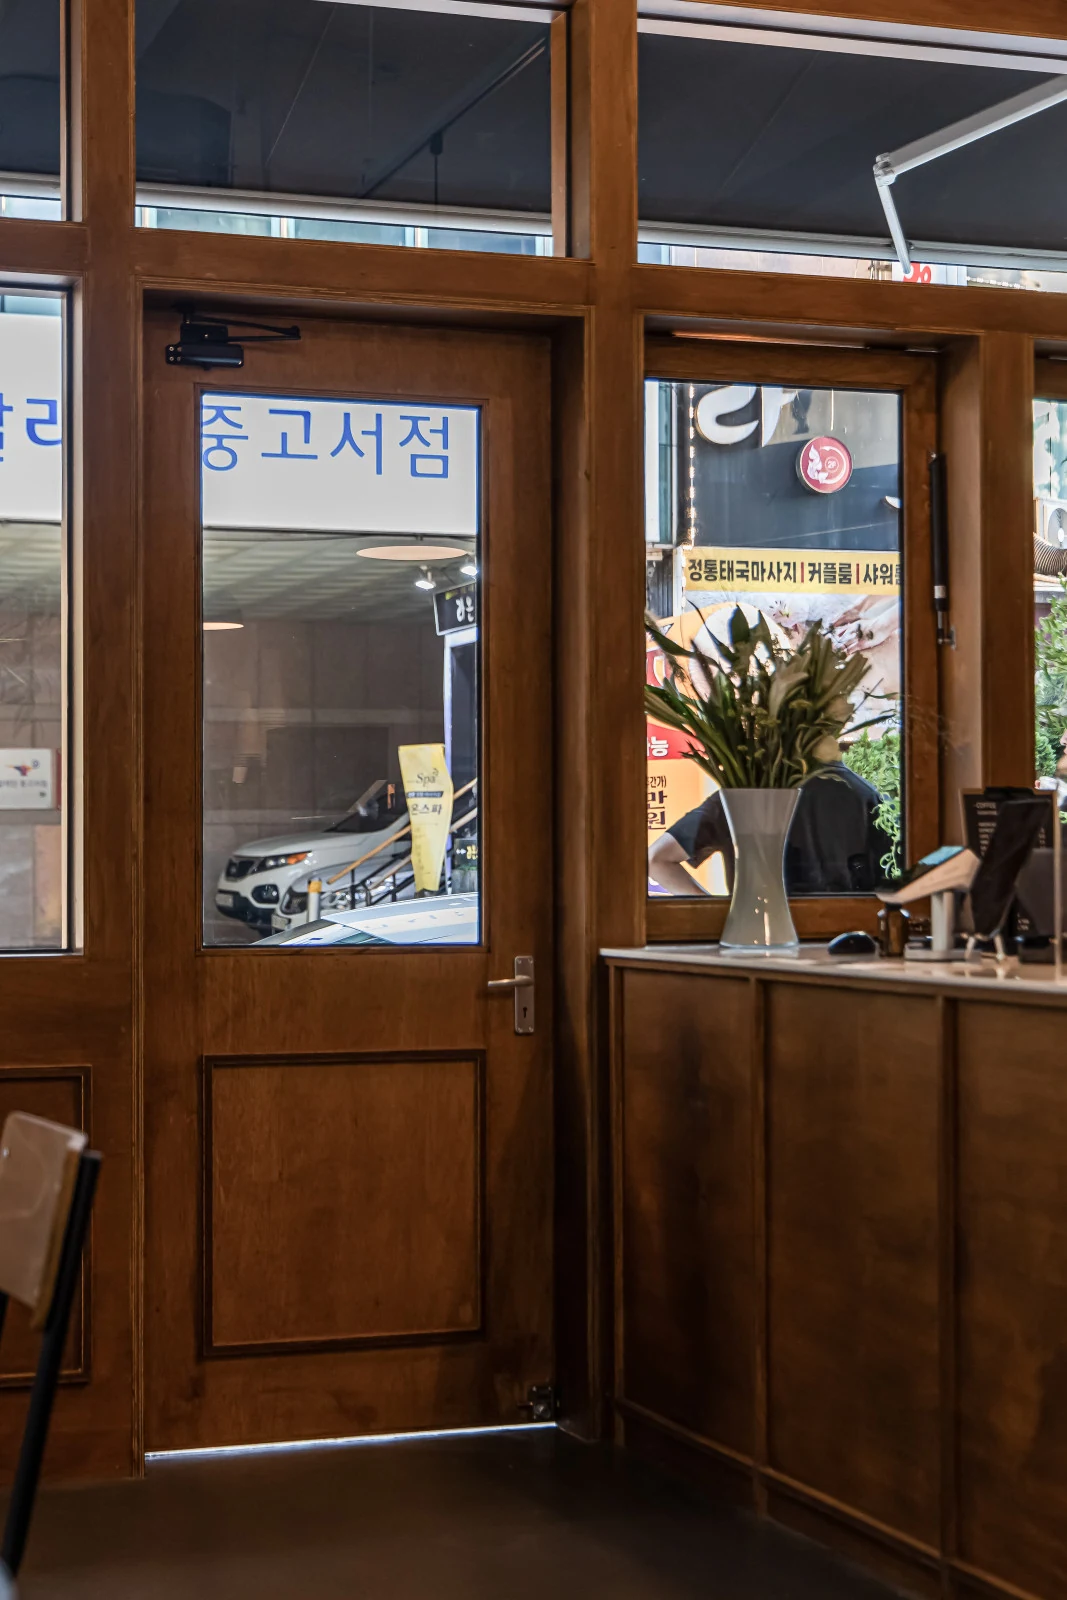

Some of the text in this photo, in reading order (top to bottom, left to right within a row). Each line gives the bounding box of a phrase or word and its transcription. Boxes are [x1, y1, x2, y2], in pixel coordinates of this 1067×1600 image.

[202, 405, 449, 479] 중고서점
[688, 559, 797, 583] 정통태국마사지
[808, 563, 853, 585] 커플룸
